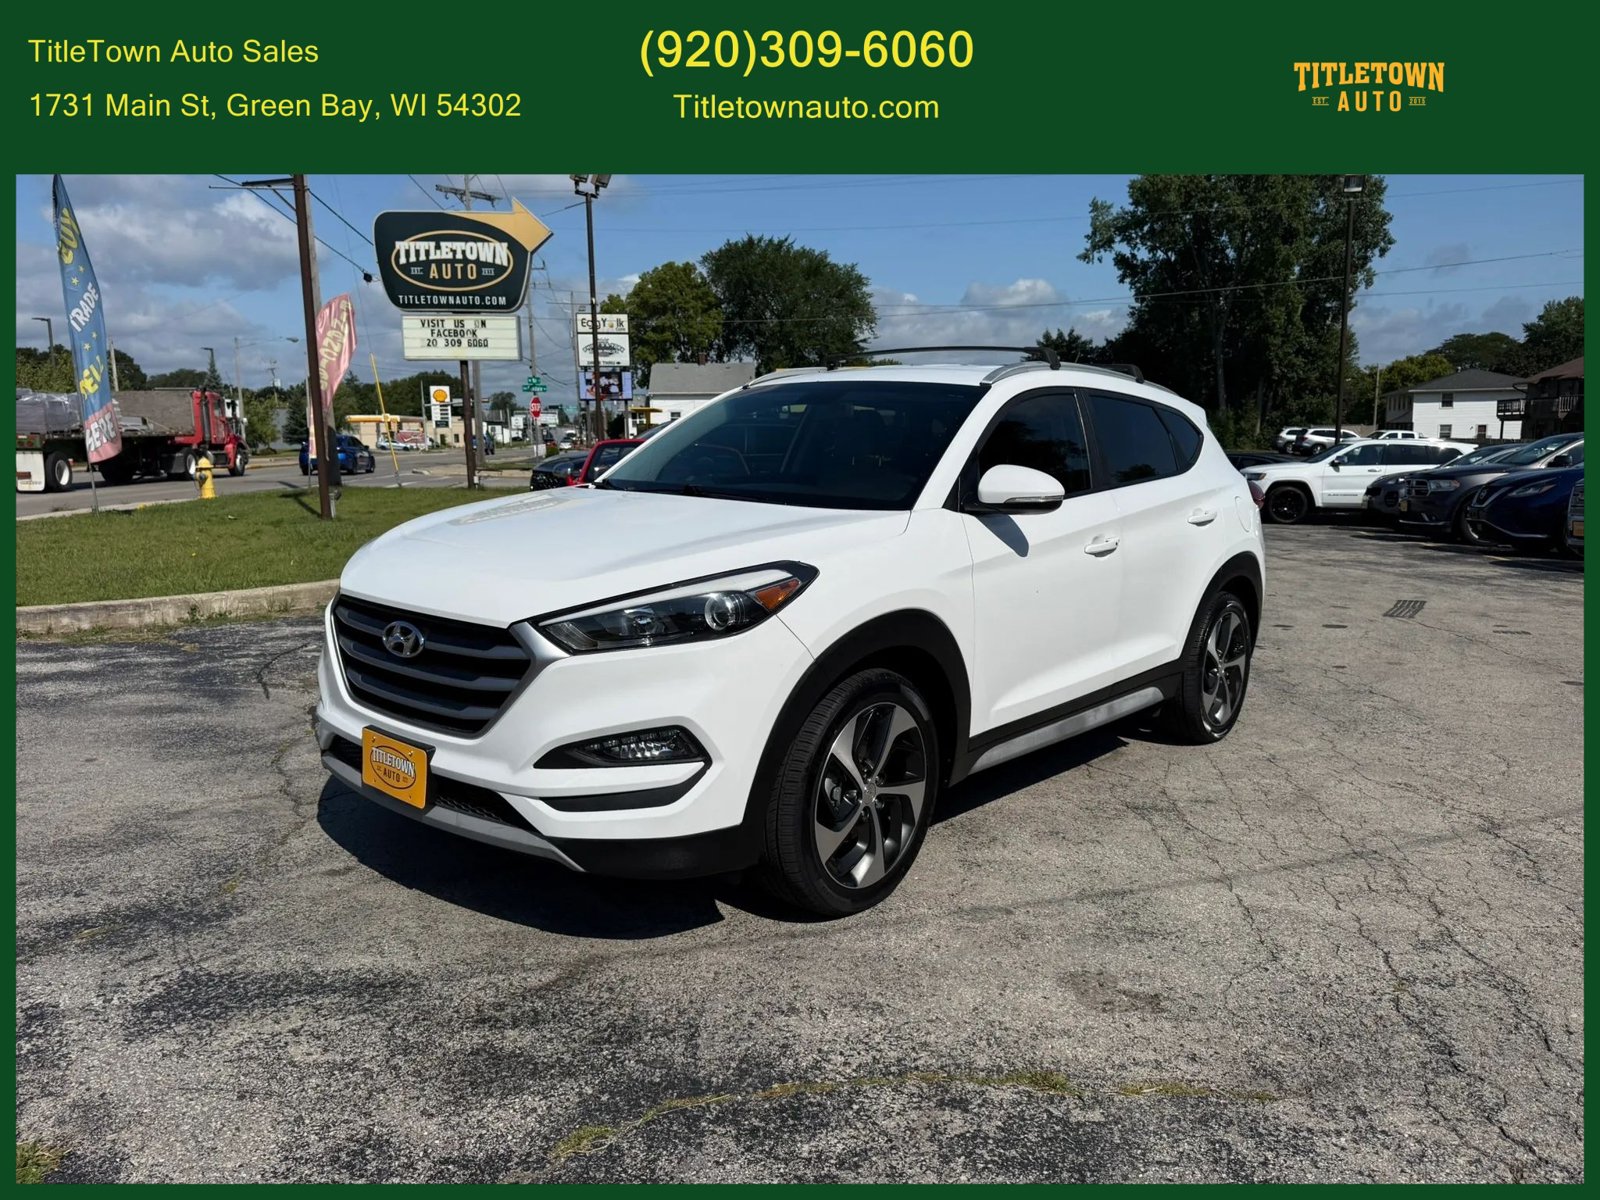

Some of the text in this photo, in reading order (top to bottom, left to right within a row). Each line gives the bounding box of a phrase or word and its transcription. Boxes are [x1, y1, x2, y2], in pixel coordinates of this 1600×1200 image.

[395, 240, 509, 267] TITLETOWN
[429, 263, 477, 280] AUTO
[69, 282, 99, 332] TRADE
[398, 294, 507, 306] TITLETOWNAUTO.COM
[420, 319, 445, 328] VISIT
[453, 319, 465, 328] US
[430, 329, 477, 338] FACEBOOK
[444, 338, 462, 347] 309
[467, 338, 488, 348] 6060
[531, 402, 541, 412] STOP
[86, 412, 116, 452] HERE
[372, 747, 415, 778] TITLETOWN
[383, 767, 401, 783] AUTO
